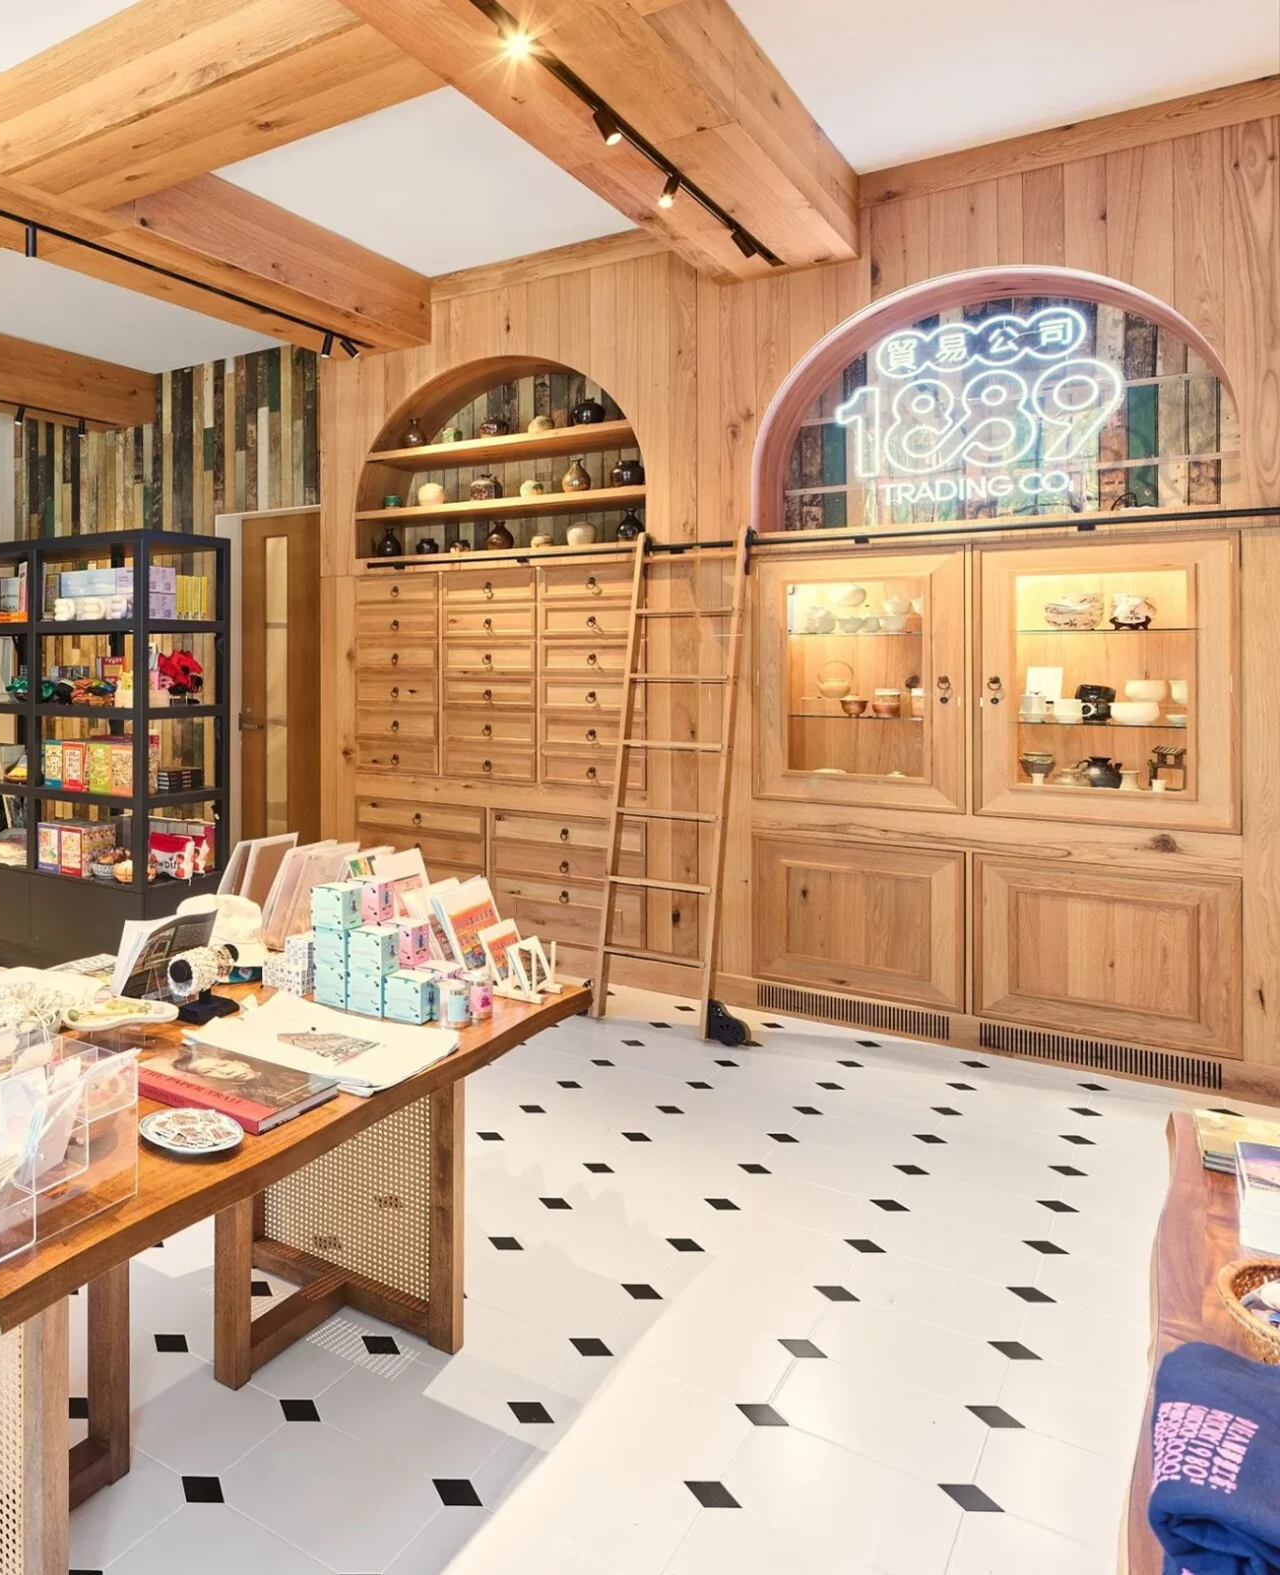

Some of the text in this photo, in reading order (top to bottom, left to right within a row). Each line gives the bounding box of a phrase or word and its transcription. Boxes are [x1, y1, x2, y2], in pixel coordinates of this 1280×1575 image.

[886, 317, 1073, 372] 貿易公司
[835, 358, 1124, 478] 1889
[883, 475, 1014, 507] TRADING
[143, 1068, 162, 1079] THE
[166, 1075, 205, 1092] PAPER
[207, 1089, 242, 1105] TRAIL
